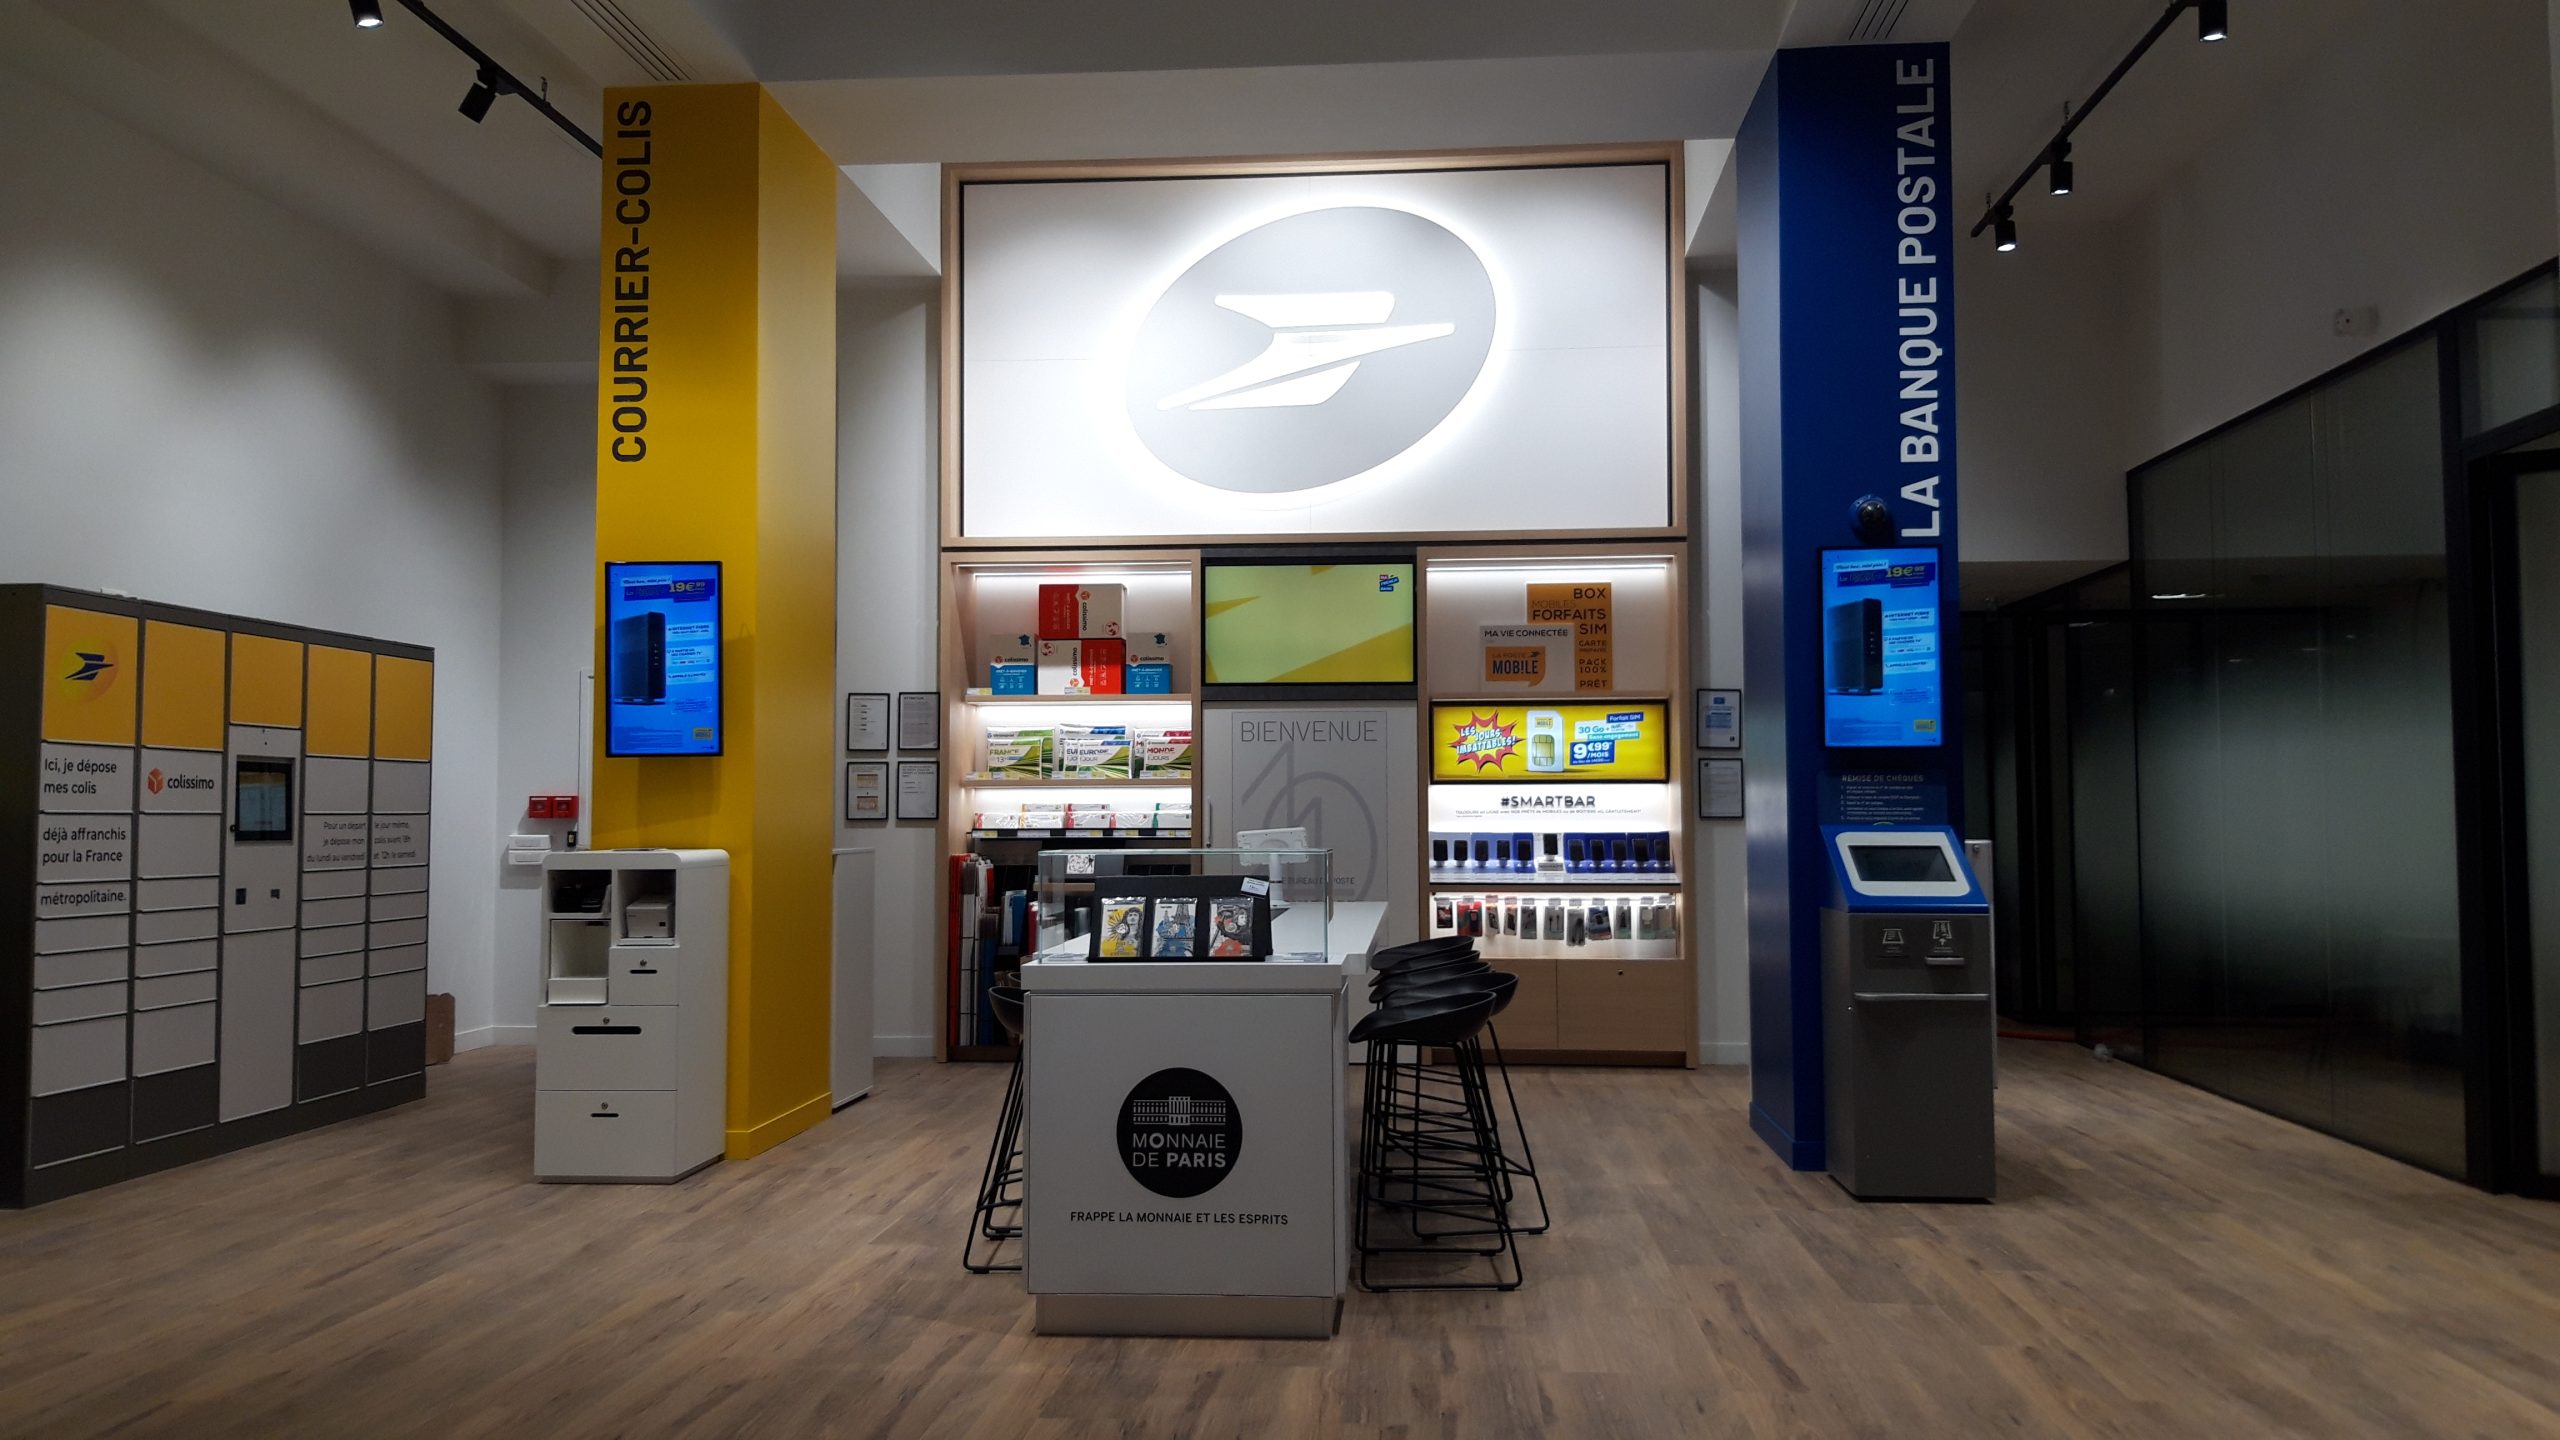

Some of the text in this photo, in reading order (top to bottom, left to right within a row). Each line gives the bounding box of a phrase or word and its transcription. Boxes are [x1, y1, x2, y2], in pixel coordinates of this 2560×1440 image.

[611, 100, 653, 463] COURRIER-COLIS
[1896, 57, 1943, 538] LA BANQUE POSTALE
[1573, 587, 1607, 600] BOX
[1531, 600, 1576, 609] MOBILES
[1532, 608, 1607, 621] FORFAITS
[1484, 628, 1568, 637] MA VIE CONNECTÉE
[1579, 623, 1607, 635] SIM
[1578, 639, 1607, 647] CARTE
[1579, 665, 1607, 673] 100%
[1579, 679, 1607, 688] PRÊT
[1240, 720, 1378, 743] BIENVENUE
[1460, 726, 1502, 741] LES JOURS
[1578, 726, 1591, 734] 30
[1592, 725, 1604, 733] Go
[990, 748, 1019, 756] FRANCE
[1147, 746, 1176, 754] MONDE
[44, 757, 117, 775] Ici, je dépose
[167, 773, 215, 790] colissimo
[1841, 774, 1872, 782] REMISE
[1873, 774, 1885, 782] DE
[44, 780, 97, 794] mes colis
[1501, 795, 1596, 807] #SMARTBAR
[43, 826, 126, 844] déjà affranchis
[42, 849, 123, 866] pour la France
[40, 889, 127, 906] métropolitaine.
[1132, 1132, 1227, 1149] MONNAIE
[1132, 1151, 1227, 1168] DE PARIS
[1070, 1211, 1289, 1225] FRAPPE LA MONNAIE ET LES ESPRITS
